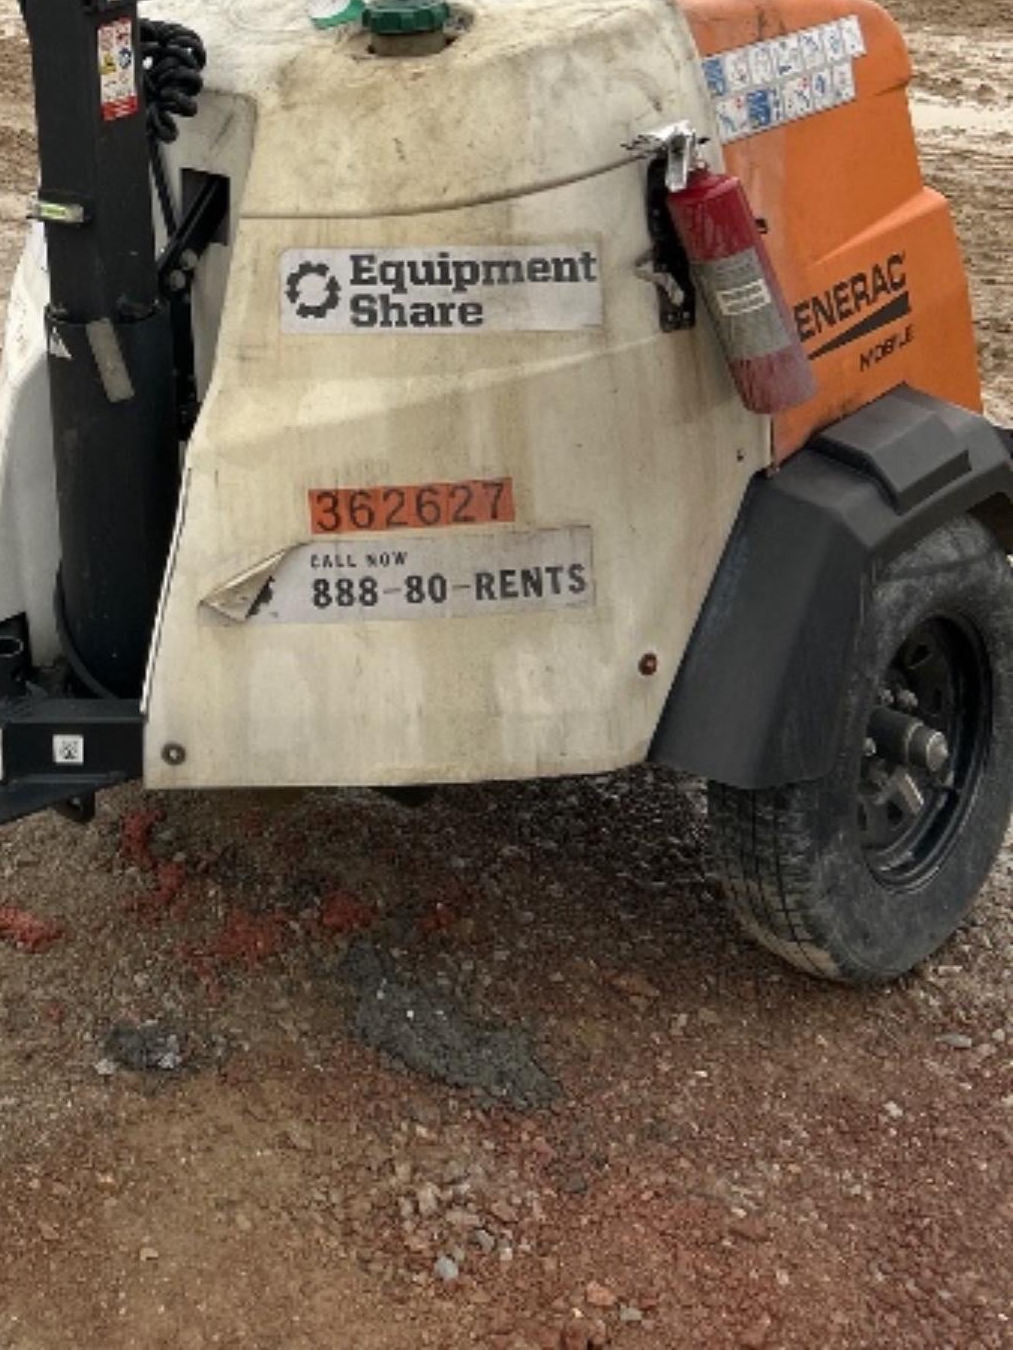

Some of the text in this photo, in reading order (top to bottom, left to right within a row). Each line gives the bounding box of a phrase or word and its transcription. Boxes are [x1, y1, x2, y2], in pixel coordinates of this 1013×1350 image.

[349, 251, 597, 294] Equipment
[349, 295, 484, 328] Share
[794, 252, 907, 342] ENERAC
[859, 323, 915, 372] MOBLE
[316, 483, 504, 531] 362627
[310, 551, 408, 569] CALL NOW
